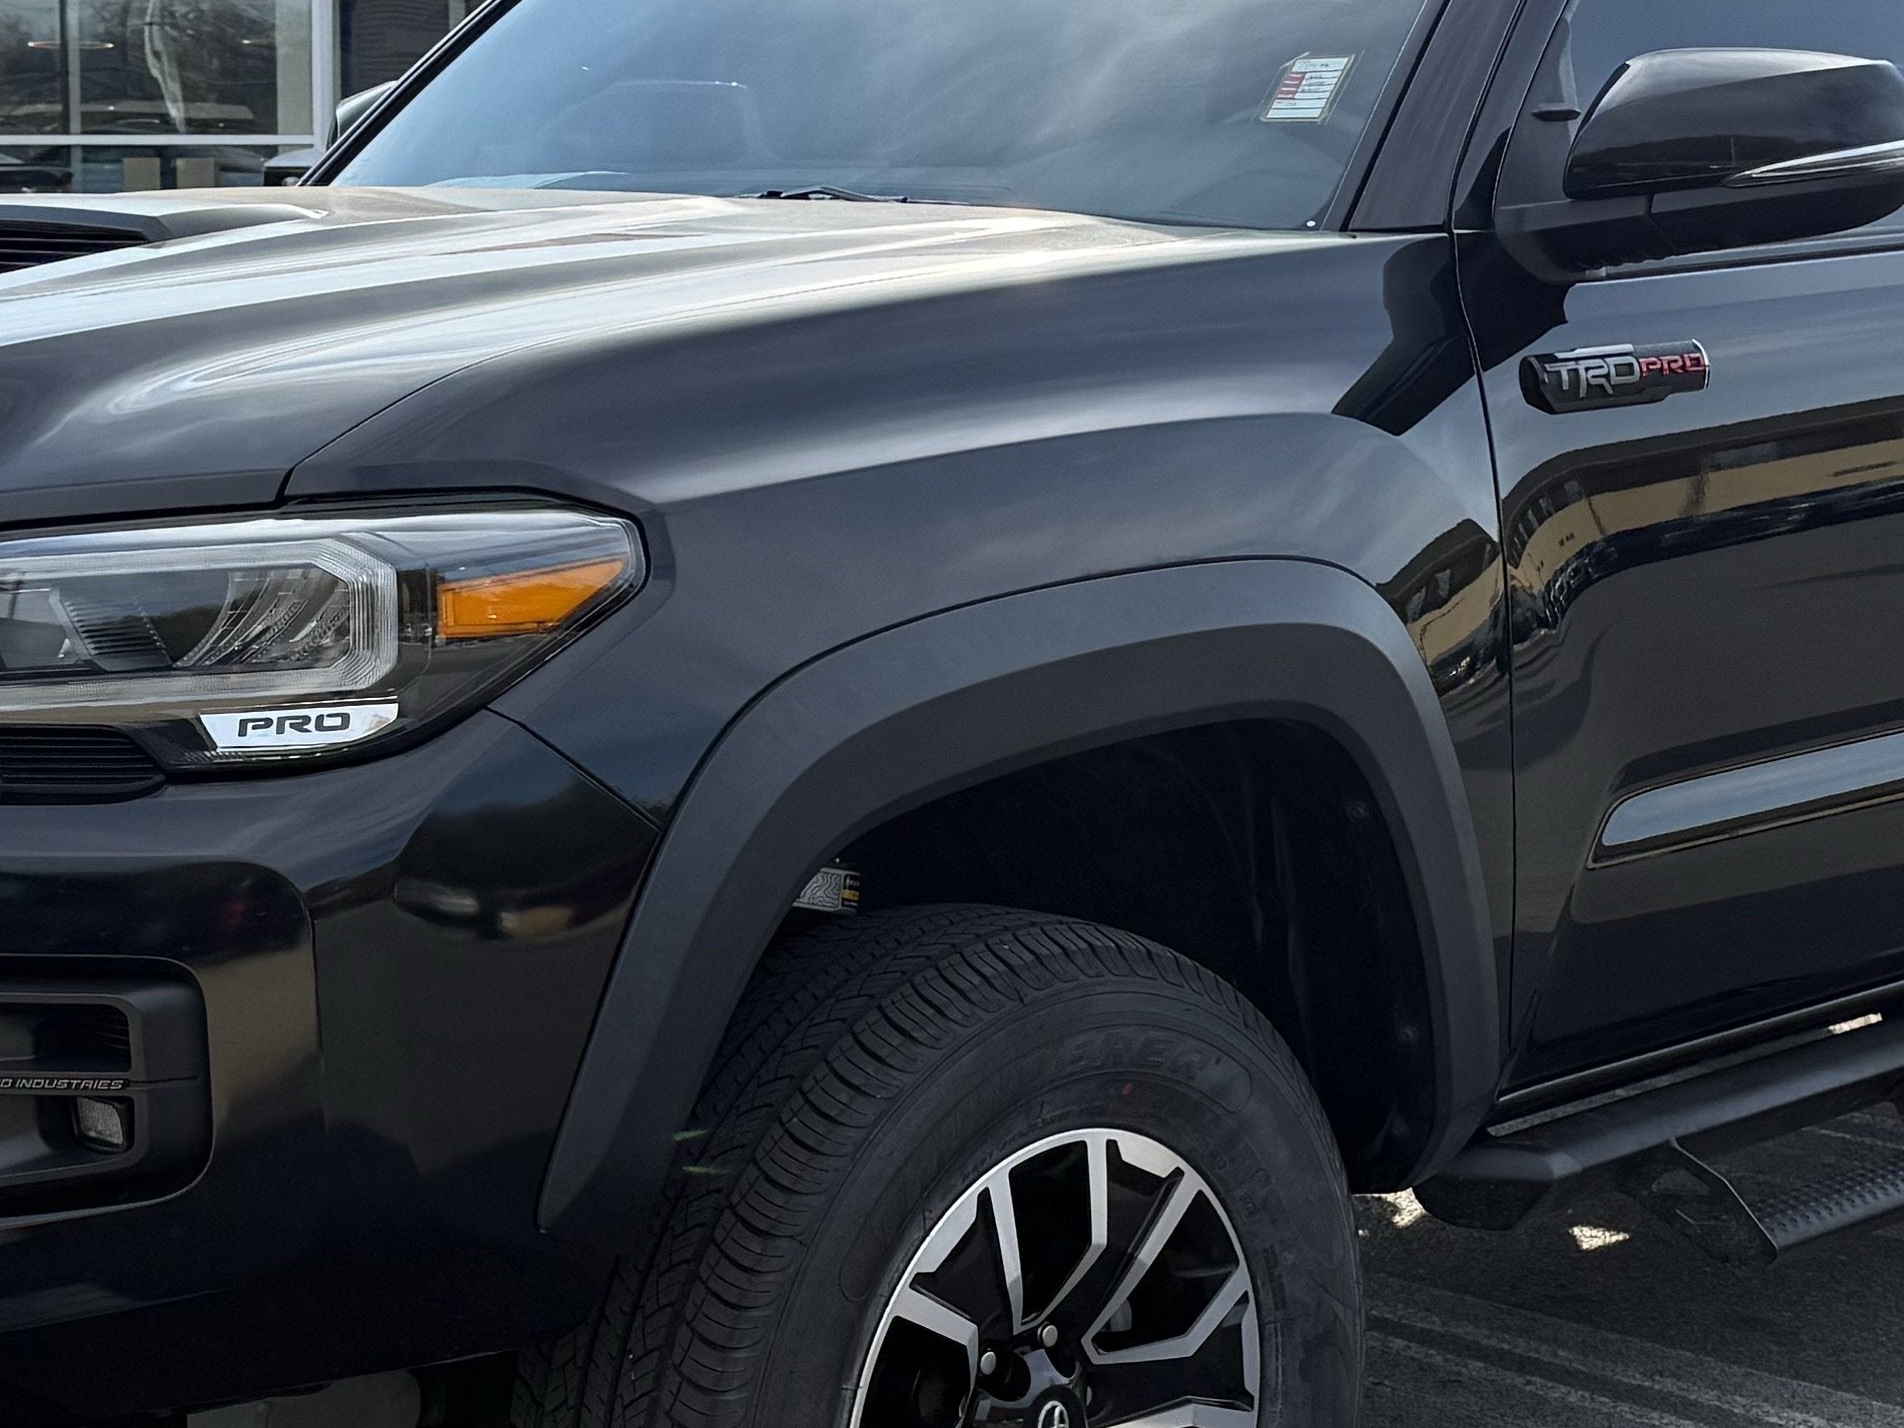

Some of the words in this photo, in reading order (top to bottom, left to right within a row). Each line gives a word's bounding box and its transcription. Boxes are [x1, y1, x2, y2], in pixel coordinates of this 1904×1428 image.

[1544, 355, 1640, 398] TRD
[1639, 352, 1706, 377] PRO
[238, 712, 351, 737] PRO
[15, 1078, 124, 1090] INDUSTRIES
